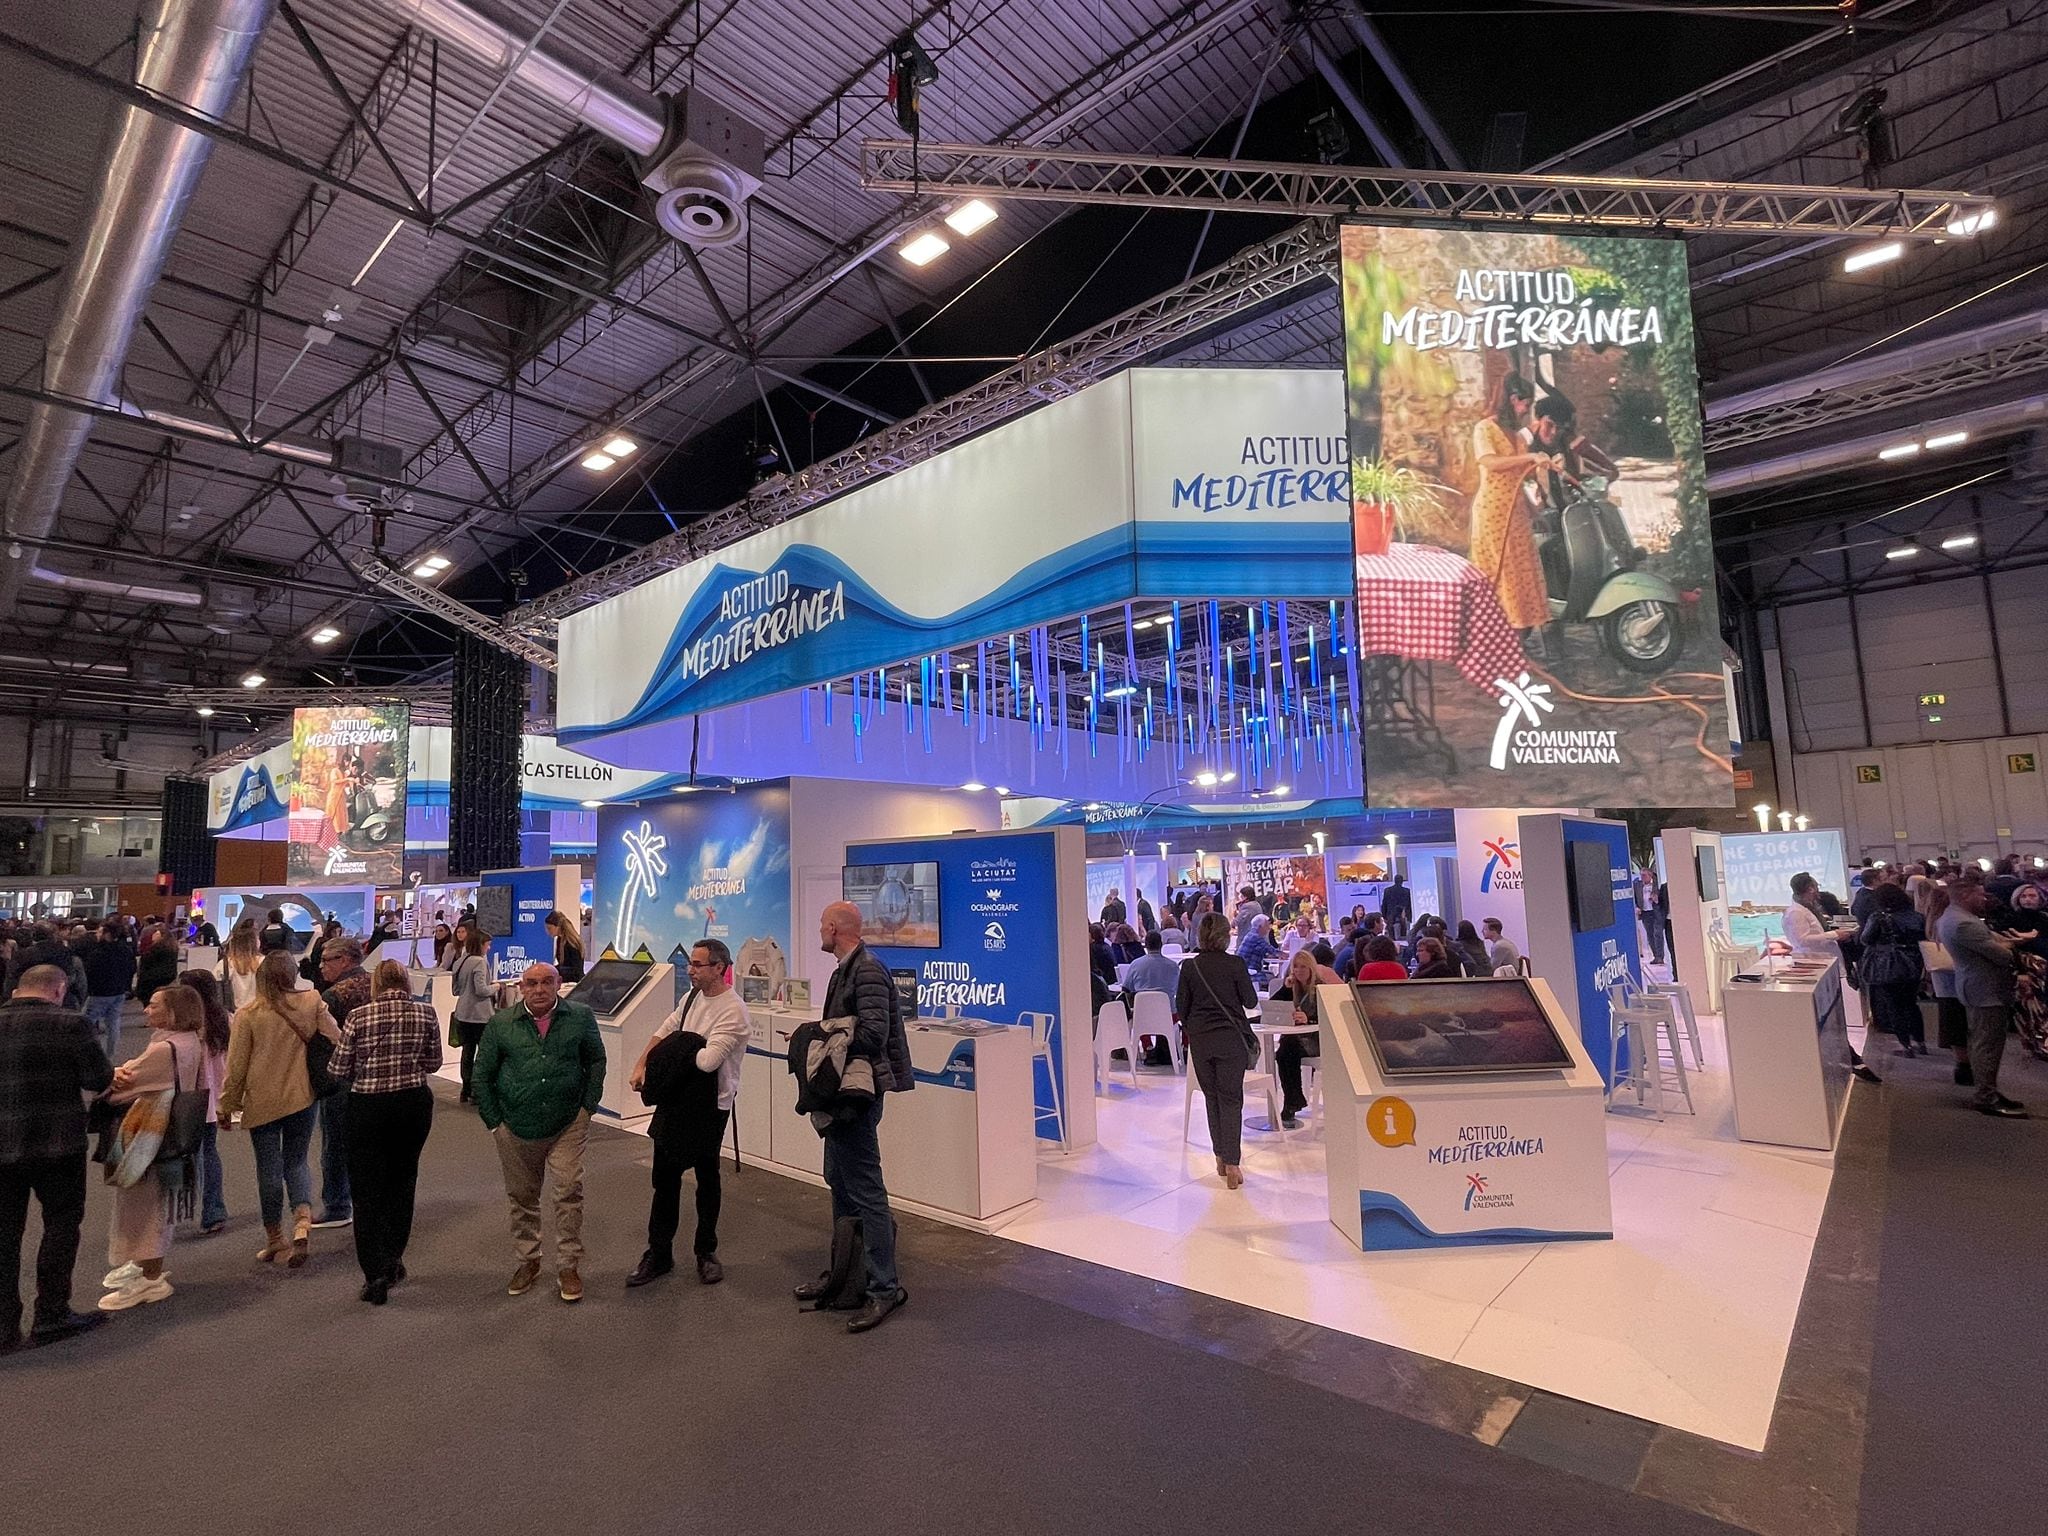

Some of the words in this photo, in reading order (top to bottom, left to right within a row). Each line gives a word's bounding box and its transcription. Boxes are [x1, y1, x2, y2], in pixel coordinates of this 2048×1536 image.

[1455, 269, 1577, 305] ACTITUD
[1382, 298, 1663, 351] MEDITERRÁNEA
[1241, 436, 1349, 465] ACTITUD
[1172, 468, 1350, 512] MEDITERR
[720, 569, 789, 623] ACTITUD
[682, 580, 845, 680] MEDITERRÁNEA
[330, 719, 371, 731] ACTITUD
[305, 726, 398, 747] MEDITERRÁNEA
[1515, 730, 1618, 747] COMUNITAT
[1511, 747, 1621, 764] VALENCIANA
[524, 763, 613, 782] CASTELLÓN
[703, 868, 728, 880] ACTITUD
[1246, 857, 1291, 872] DESCARGA
[1261, 869, 1271, 879] LA
[688, 877, 746, 900] MEDITERRÁNEA
[518, 913, 535, 922] ACTIVO
[923, 961, 970, 981] ACTITUD
[917, 977, 1006, 1007] DITERRÁNEA
[1458, 1125, 1508, 1142] ACTITUD
[1428, 1136, 1544, 1165] MEDITERRÁNEA
[1473, 1201, 1514, 1209] VALENCIANA
[1474, 1194, 1513, 1202] COMUNITAT
